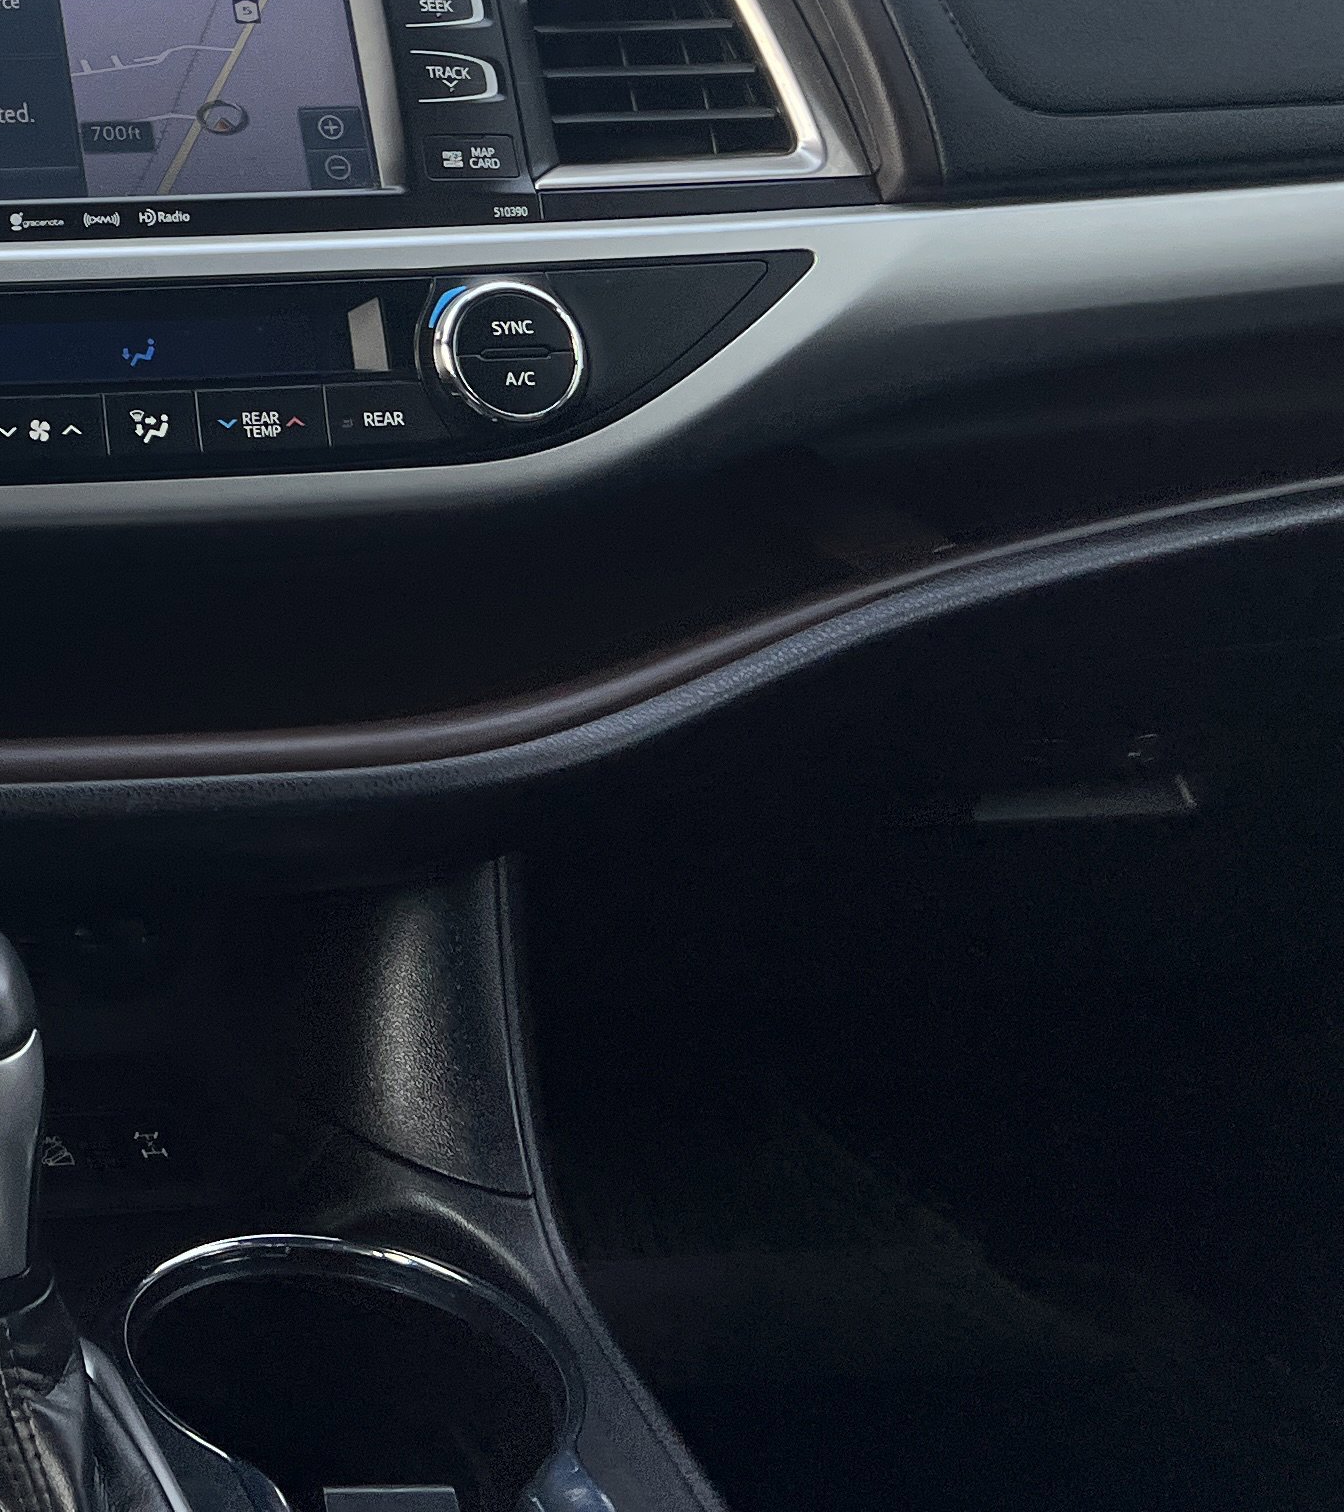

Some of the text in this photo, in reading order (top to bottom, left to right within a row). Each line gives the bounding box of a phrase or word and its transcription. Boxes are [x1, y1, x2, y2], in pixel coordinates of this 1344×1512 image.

[425, 65, 471, 80] TRACK
[89, 124, 142, 142] 700ft
[470, 146, 496, 158] MAP
[469, 157, 501, 170] CARD
[157, 210, 191, 223] Radio
[493, 206, 529, 219] 510390
[490, 319, 535, 336] SYNC
[505, 371, 537, 387] A/C
[241, 411, 280, 426] REAR
[363, 411, 406, 427] REAR
[243, 424, 282, 439] TEMP
